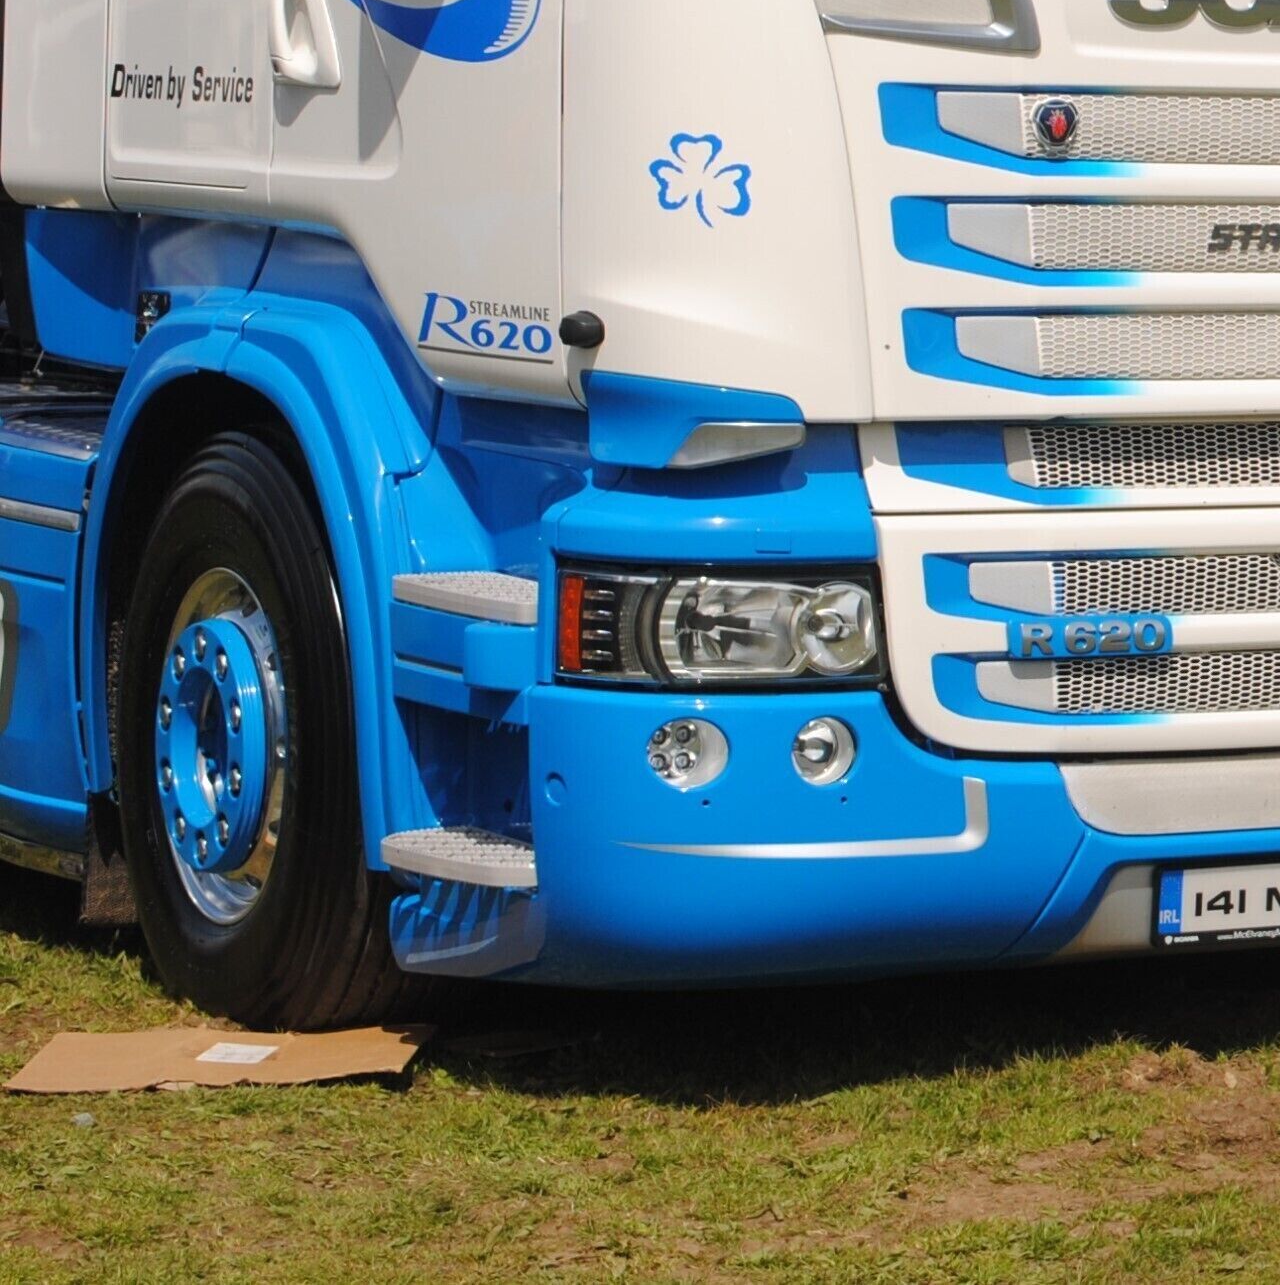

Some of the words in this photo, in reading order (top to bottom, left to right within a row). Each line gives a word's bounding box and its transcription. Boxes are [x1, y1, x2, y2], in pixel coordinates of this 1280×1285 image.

[111, 64, 161, 102] Driven
[167, 67, 186, 108] by
[192, 67, 253, 104] Service
[469, 300, 551, 322] STREAMLINE
[1020, 623, 1056, 656] R
[1065, 618, 1166, 654] 620
[1159, 910, 1180, 924] IRL
[1195, 889, 1246, 917] 141
